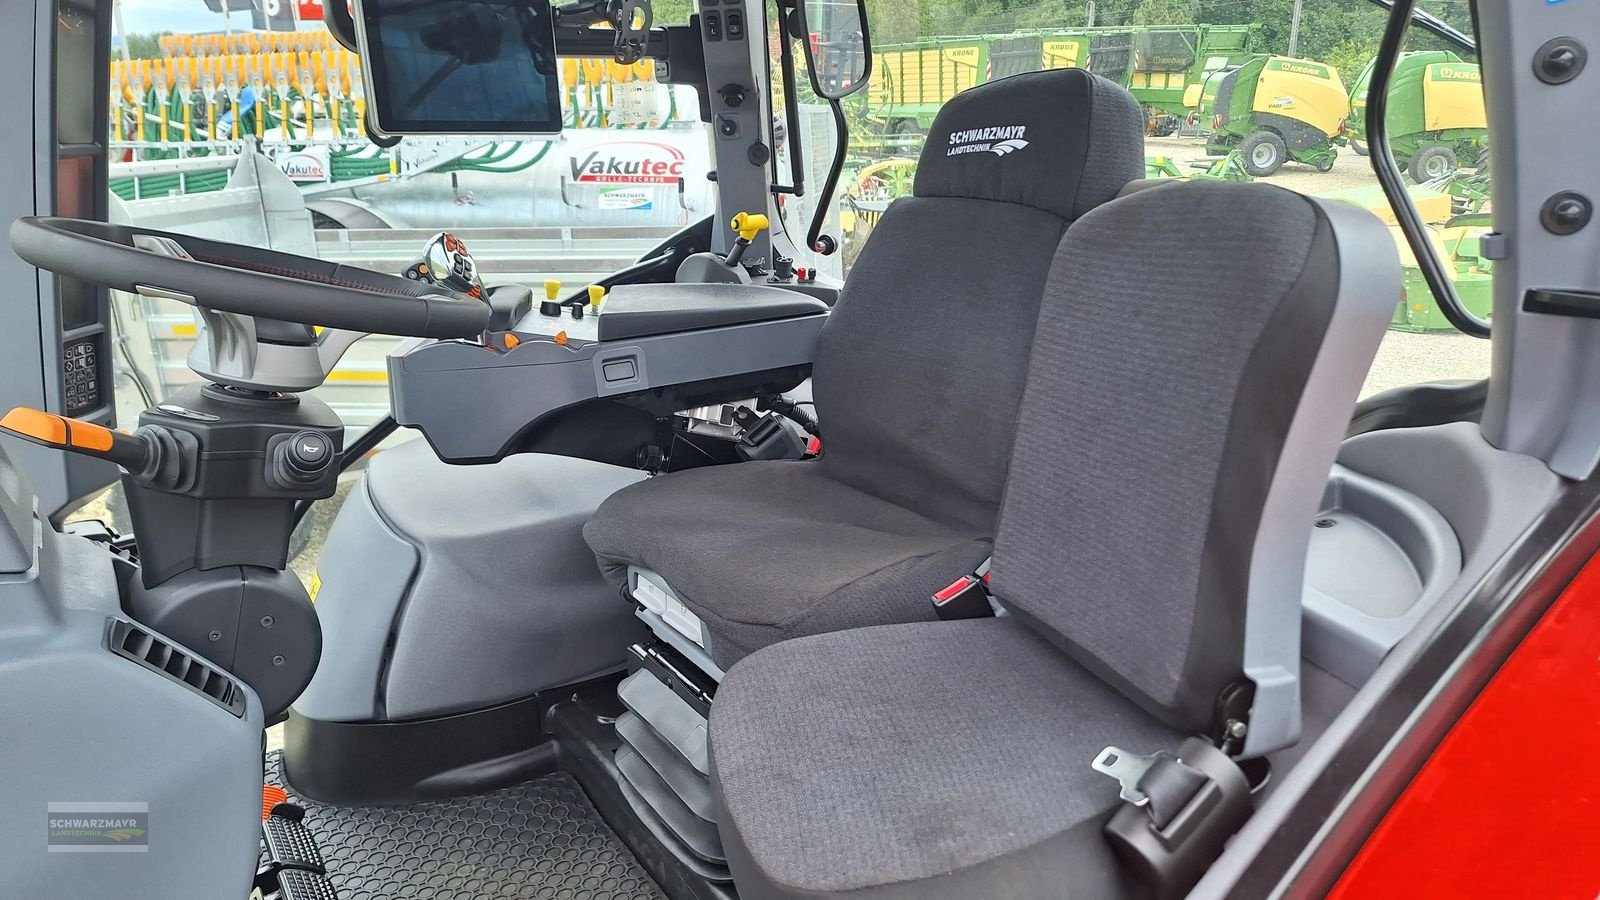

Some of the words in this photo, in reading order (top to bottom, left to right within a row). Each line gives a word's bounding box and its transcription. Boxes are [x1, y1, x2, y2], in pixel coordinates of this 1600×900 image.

[952, 49, 975, 57] KRONE
[1290, 66, 1321, 76] KRONE
[949, 126, 1026, 144] SCHWARZMAYR
[947, 143, 992, 156] LANDTECHNIK
[281, 162, 324, 176] Vakutec
[569, 151, 684, 182] Vakutec
